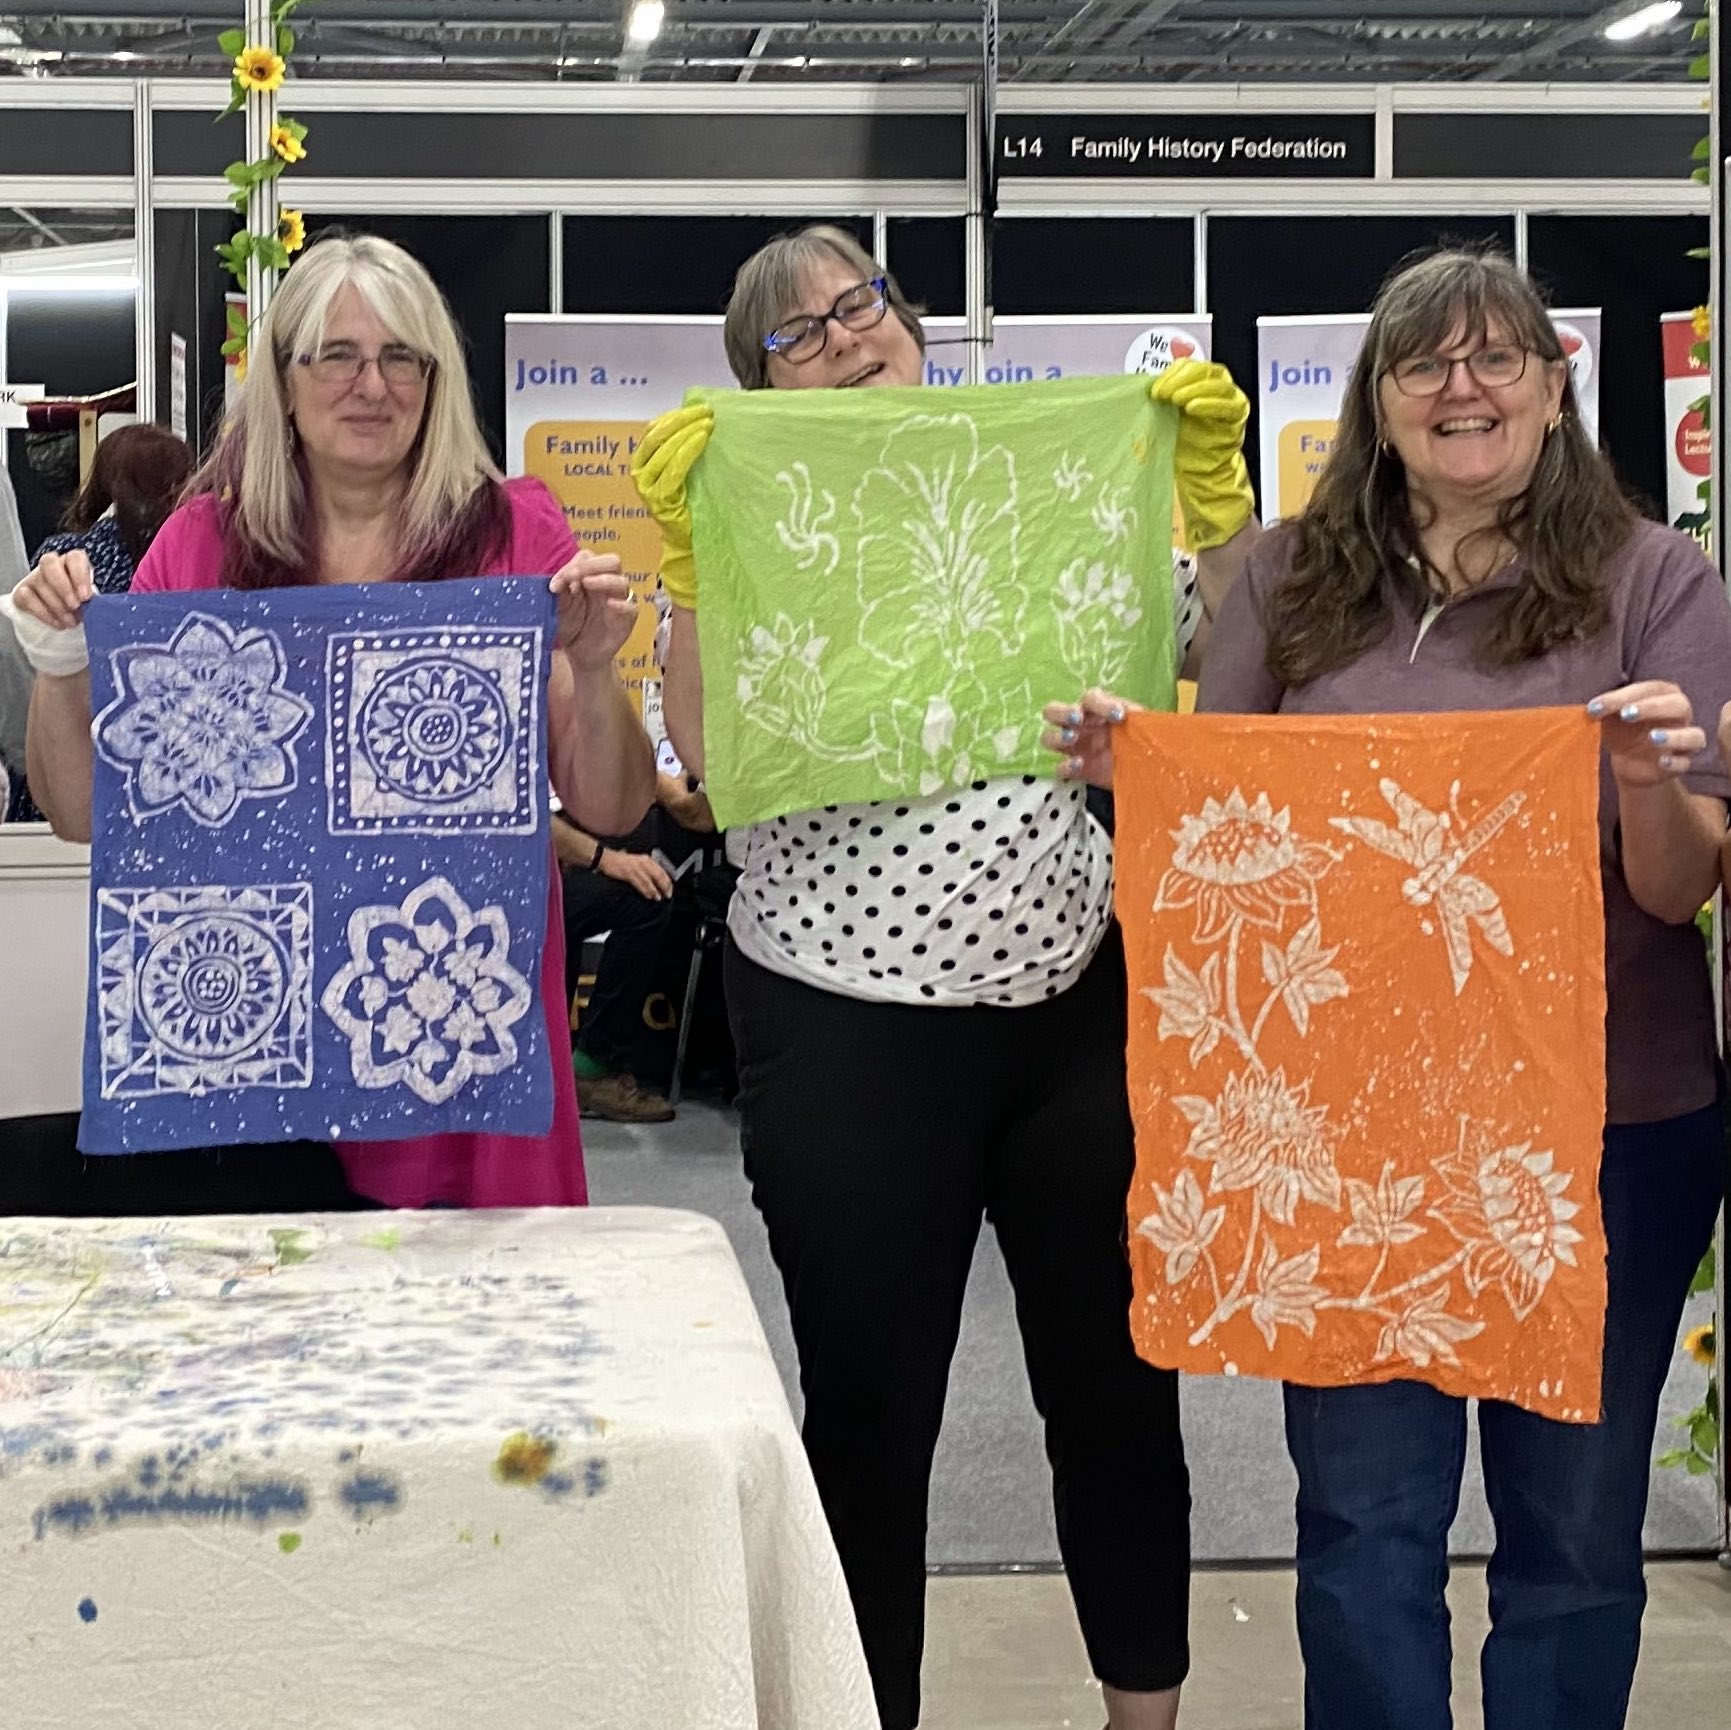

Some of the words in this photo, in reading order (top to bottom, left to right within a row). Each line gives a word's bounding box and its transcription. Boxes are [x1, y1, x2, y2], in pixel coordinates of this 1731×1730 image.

[1003, 136, 1043, 158] L14
[1071, 136, 1142, 163] Family
[1148, 136, 1225, 163] History
[1231, 136, 1346, 158] Federation
[1150, 333, 1168, 352] We
[1142, 350, 1172, 369] Fam
[515, 358, 578, 391] Join
[590, 366, 608, 385] a
[927, 360, 964, 386] hy
[985, 359, 1033, 383] oin
[1269, 359, 1332, 392] Join
[546, 435, 620, 460] Family
[564, 463, 613, 476] LOCAL
[562, 505, 603, 519] Meet
[574, 526, 621, 543] eople,
